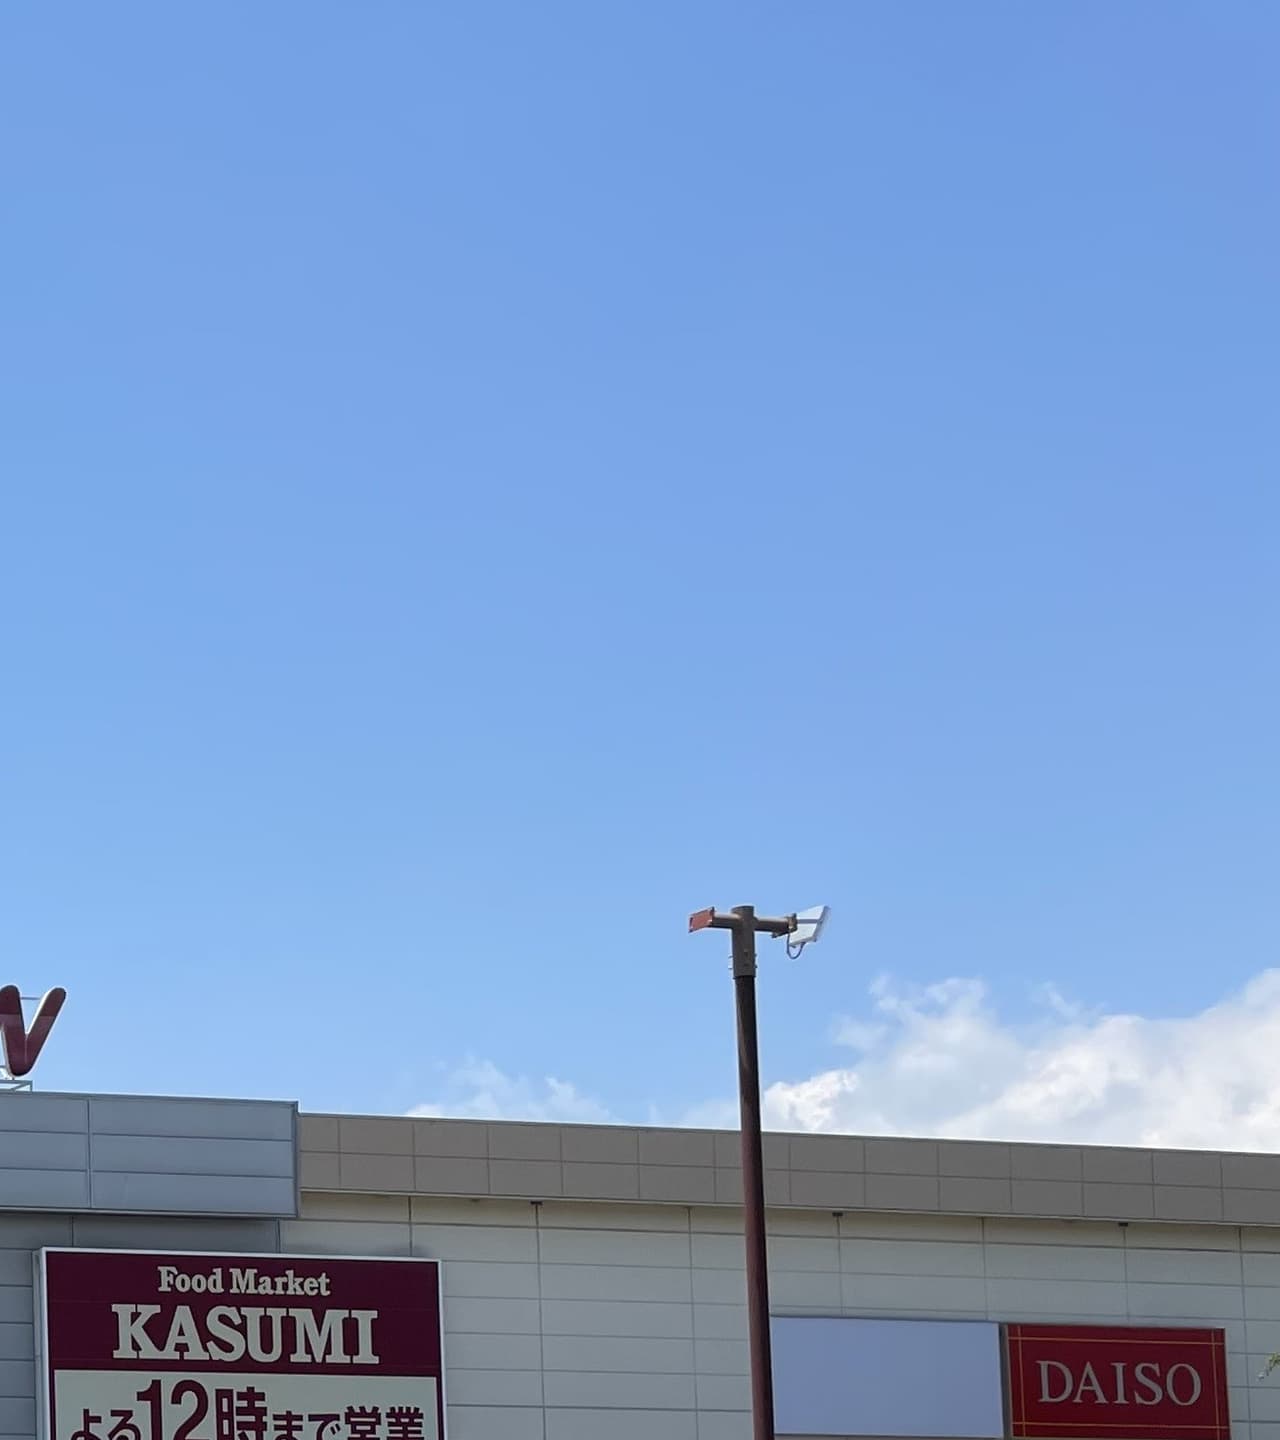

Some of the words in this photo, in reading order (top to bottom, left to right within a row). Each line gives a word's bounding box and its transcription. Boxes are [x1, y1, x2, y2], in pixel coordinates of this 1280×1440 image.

[157, 1265, 224, 1294] Food
[229, 1267, 331, 1297] Market
[110, 1303, 380, 1365] KASUMI
[1035, 1360, 1202, 1406] DAISO
